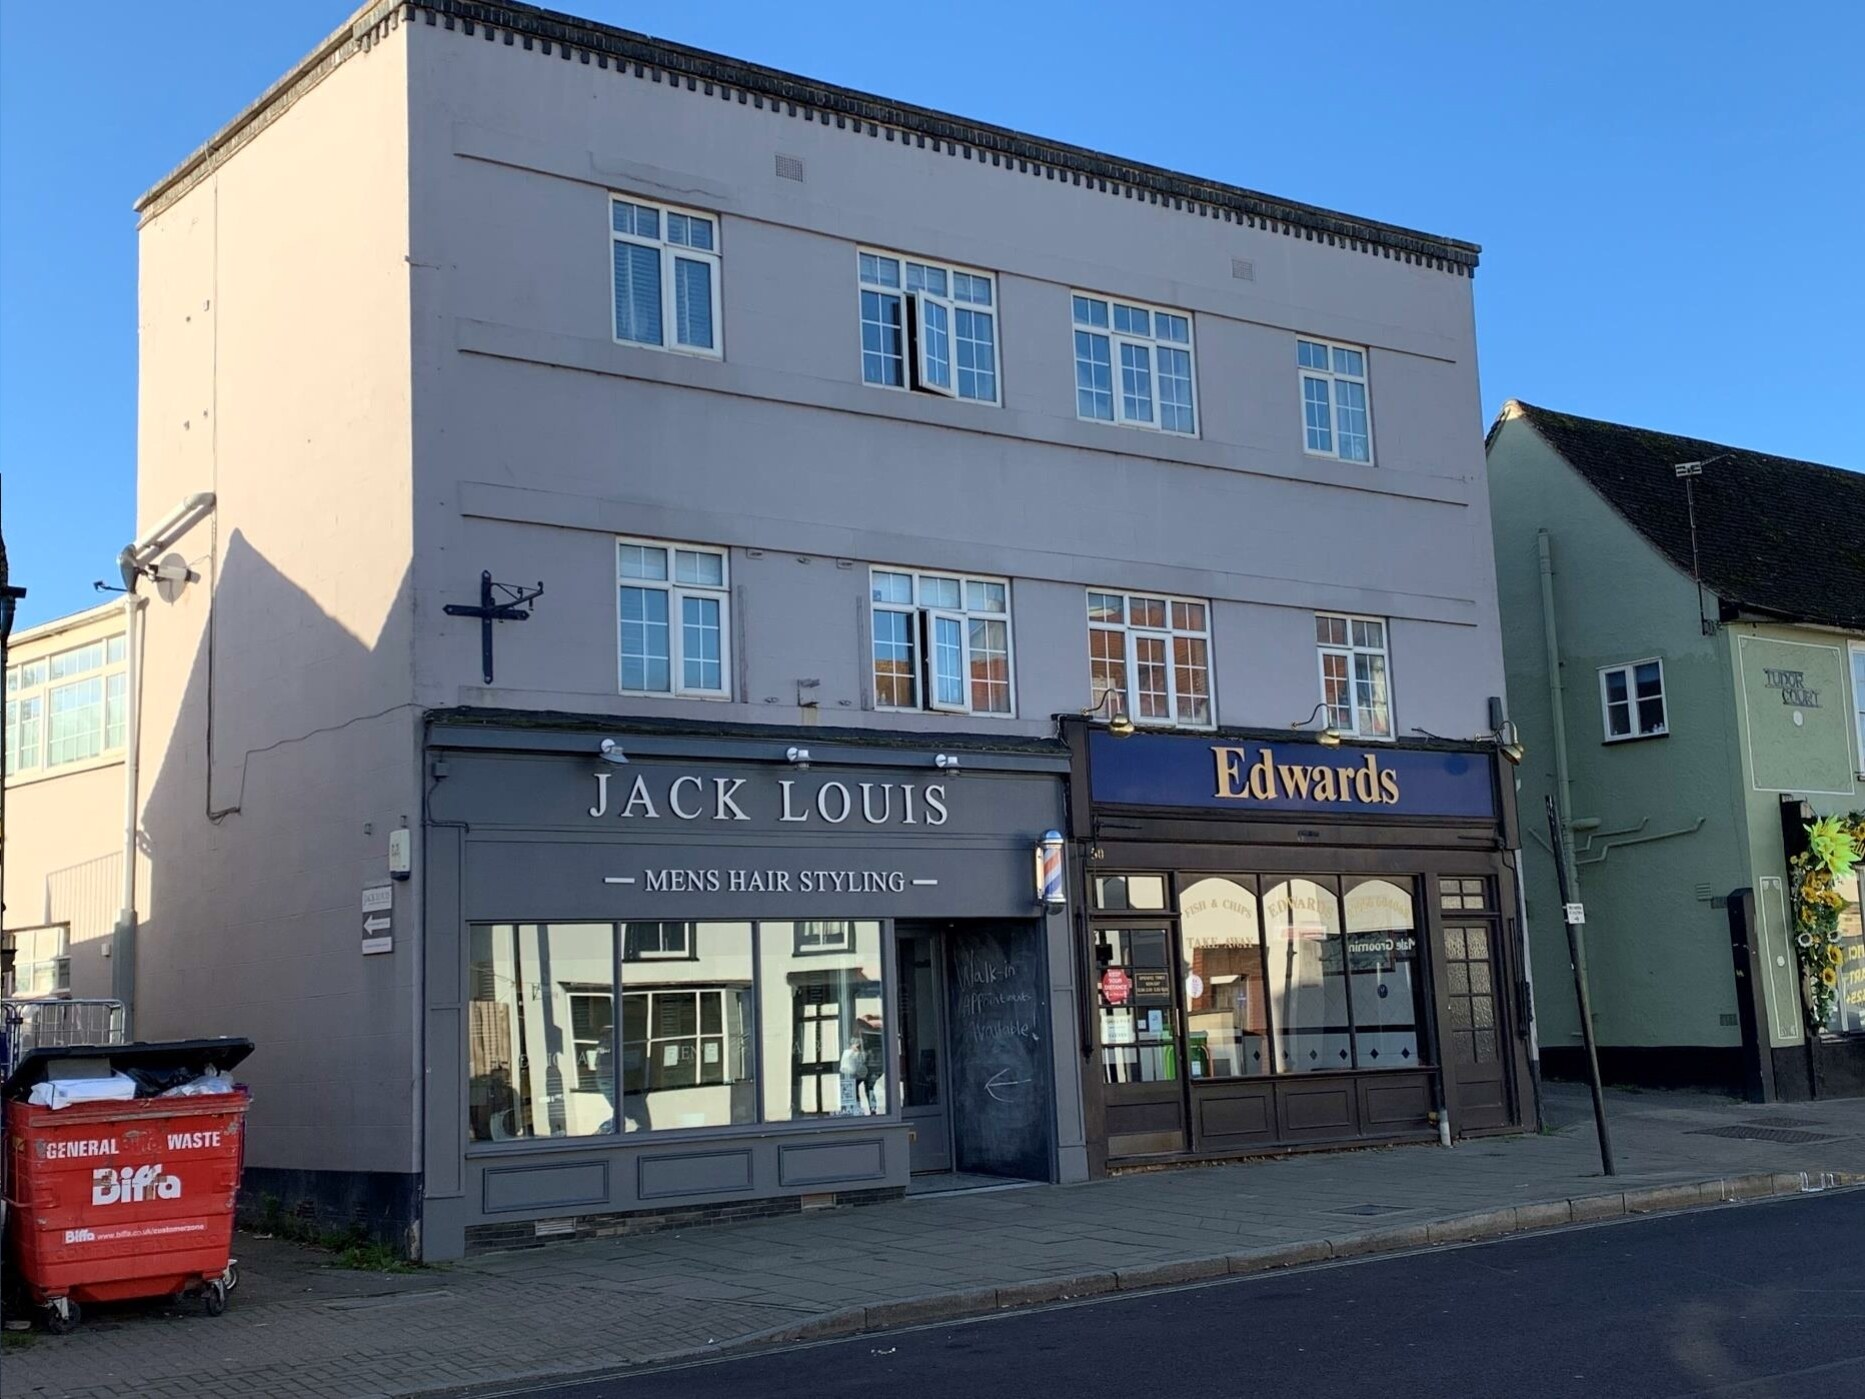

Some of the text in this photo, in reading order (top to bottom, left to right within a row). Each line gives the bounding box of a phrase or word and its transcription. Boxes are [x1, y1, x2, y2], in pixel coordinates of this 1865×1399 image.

[1763, 668, 1805, 689] TUDOR
[1781, 688, 1820, 708] COURT
[1210, 746, 1399, 804] Edwards
[589, 773, 948, 826] JACK LOUIS
[645, 869, 905, 893] MENS HAIR STYLING
[1185, 898, 1253, 919] FISH & CHIPS
[1267, 895, 1334, 919] EDWARDS
[1186, 936, 1254, 949] TAKE AWAY
[953, 949, 1016, 992] Walk-in
[46, 1131, 221, 1160] GENERAL WASTE
[92, 1163, 182, 1206] Biffa
[64, 1228, 95, 1244] Biffa
